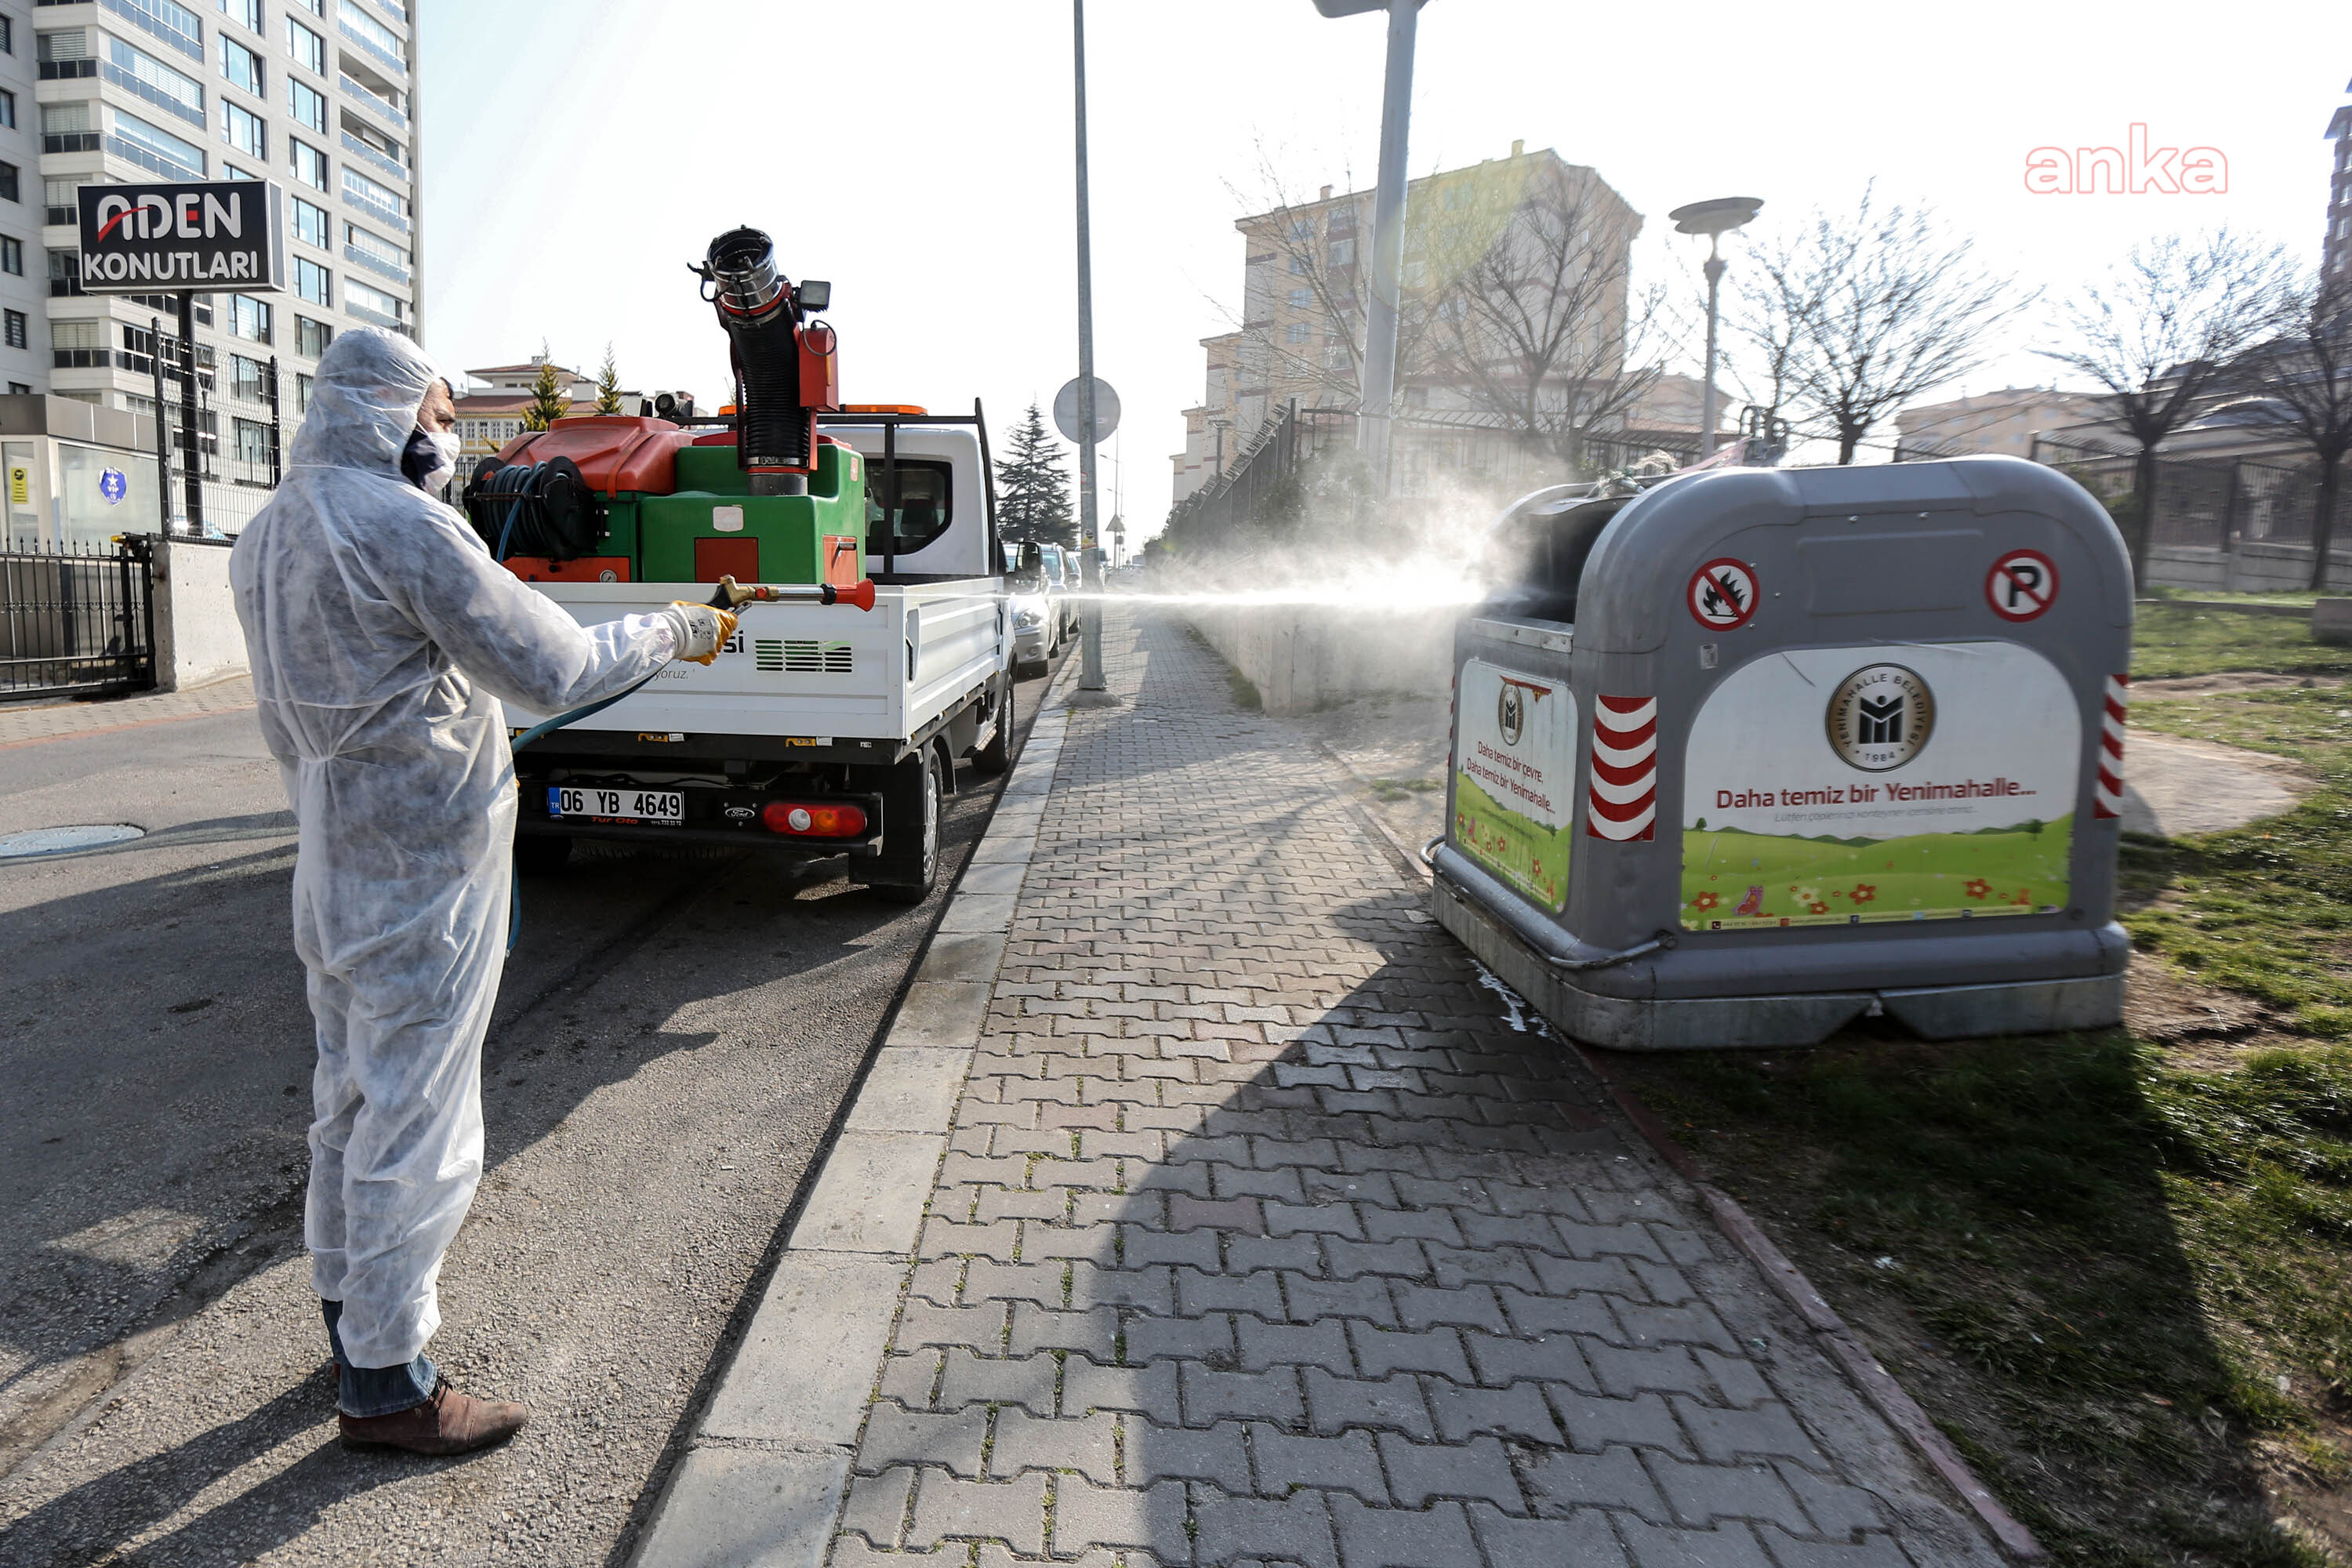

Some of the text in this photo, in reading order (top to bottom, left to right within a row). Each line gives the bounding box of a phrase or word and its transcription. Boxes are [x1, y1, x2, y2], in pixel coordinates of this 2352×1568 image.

[97, 192, 241, 241] ADEN
[85, 251, 258, 280] KONUTLARI
[1467, 757, 1481, 775] Daha
[1483, 766, 1500, 785] temiz
[1500, 773, 1509, 789] bir
[1478, 741, 1544, 784] Daha temiz bir çevre,
[560, 789, 681, 817] 06 YB 4649
[1716, 777, 2038, 808] Daha temiz bir Yenimahalle...
